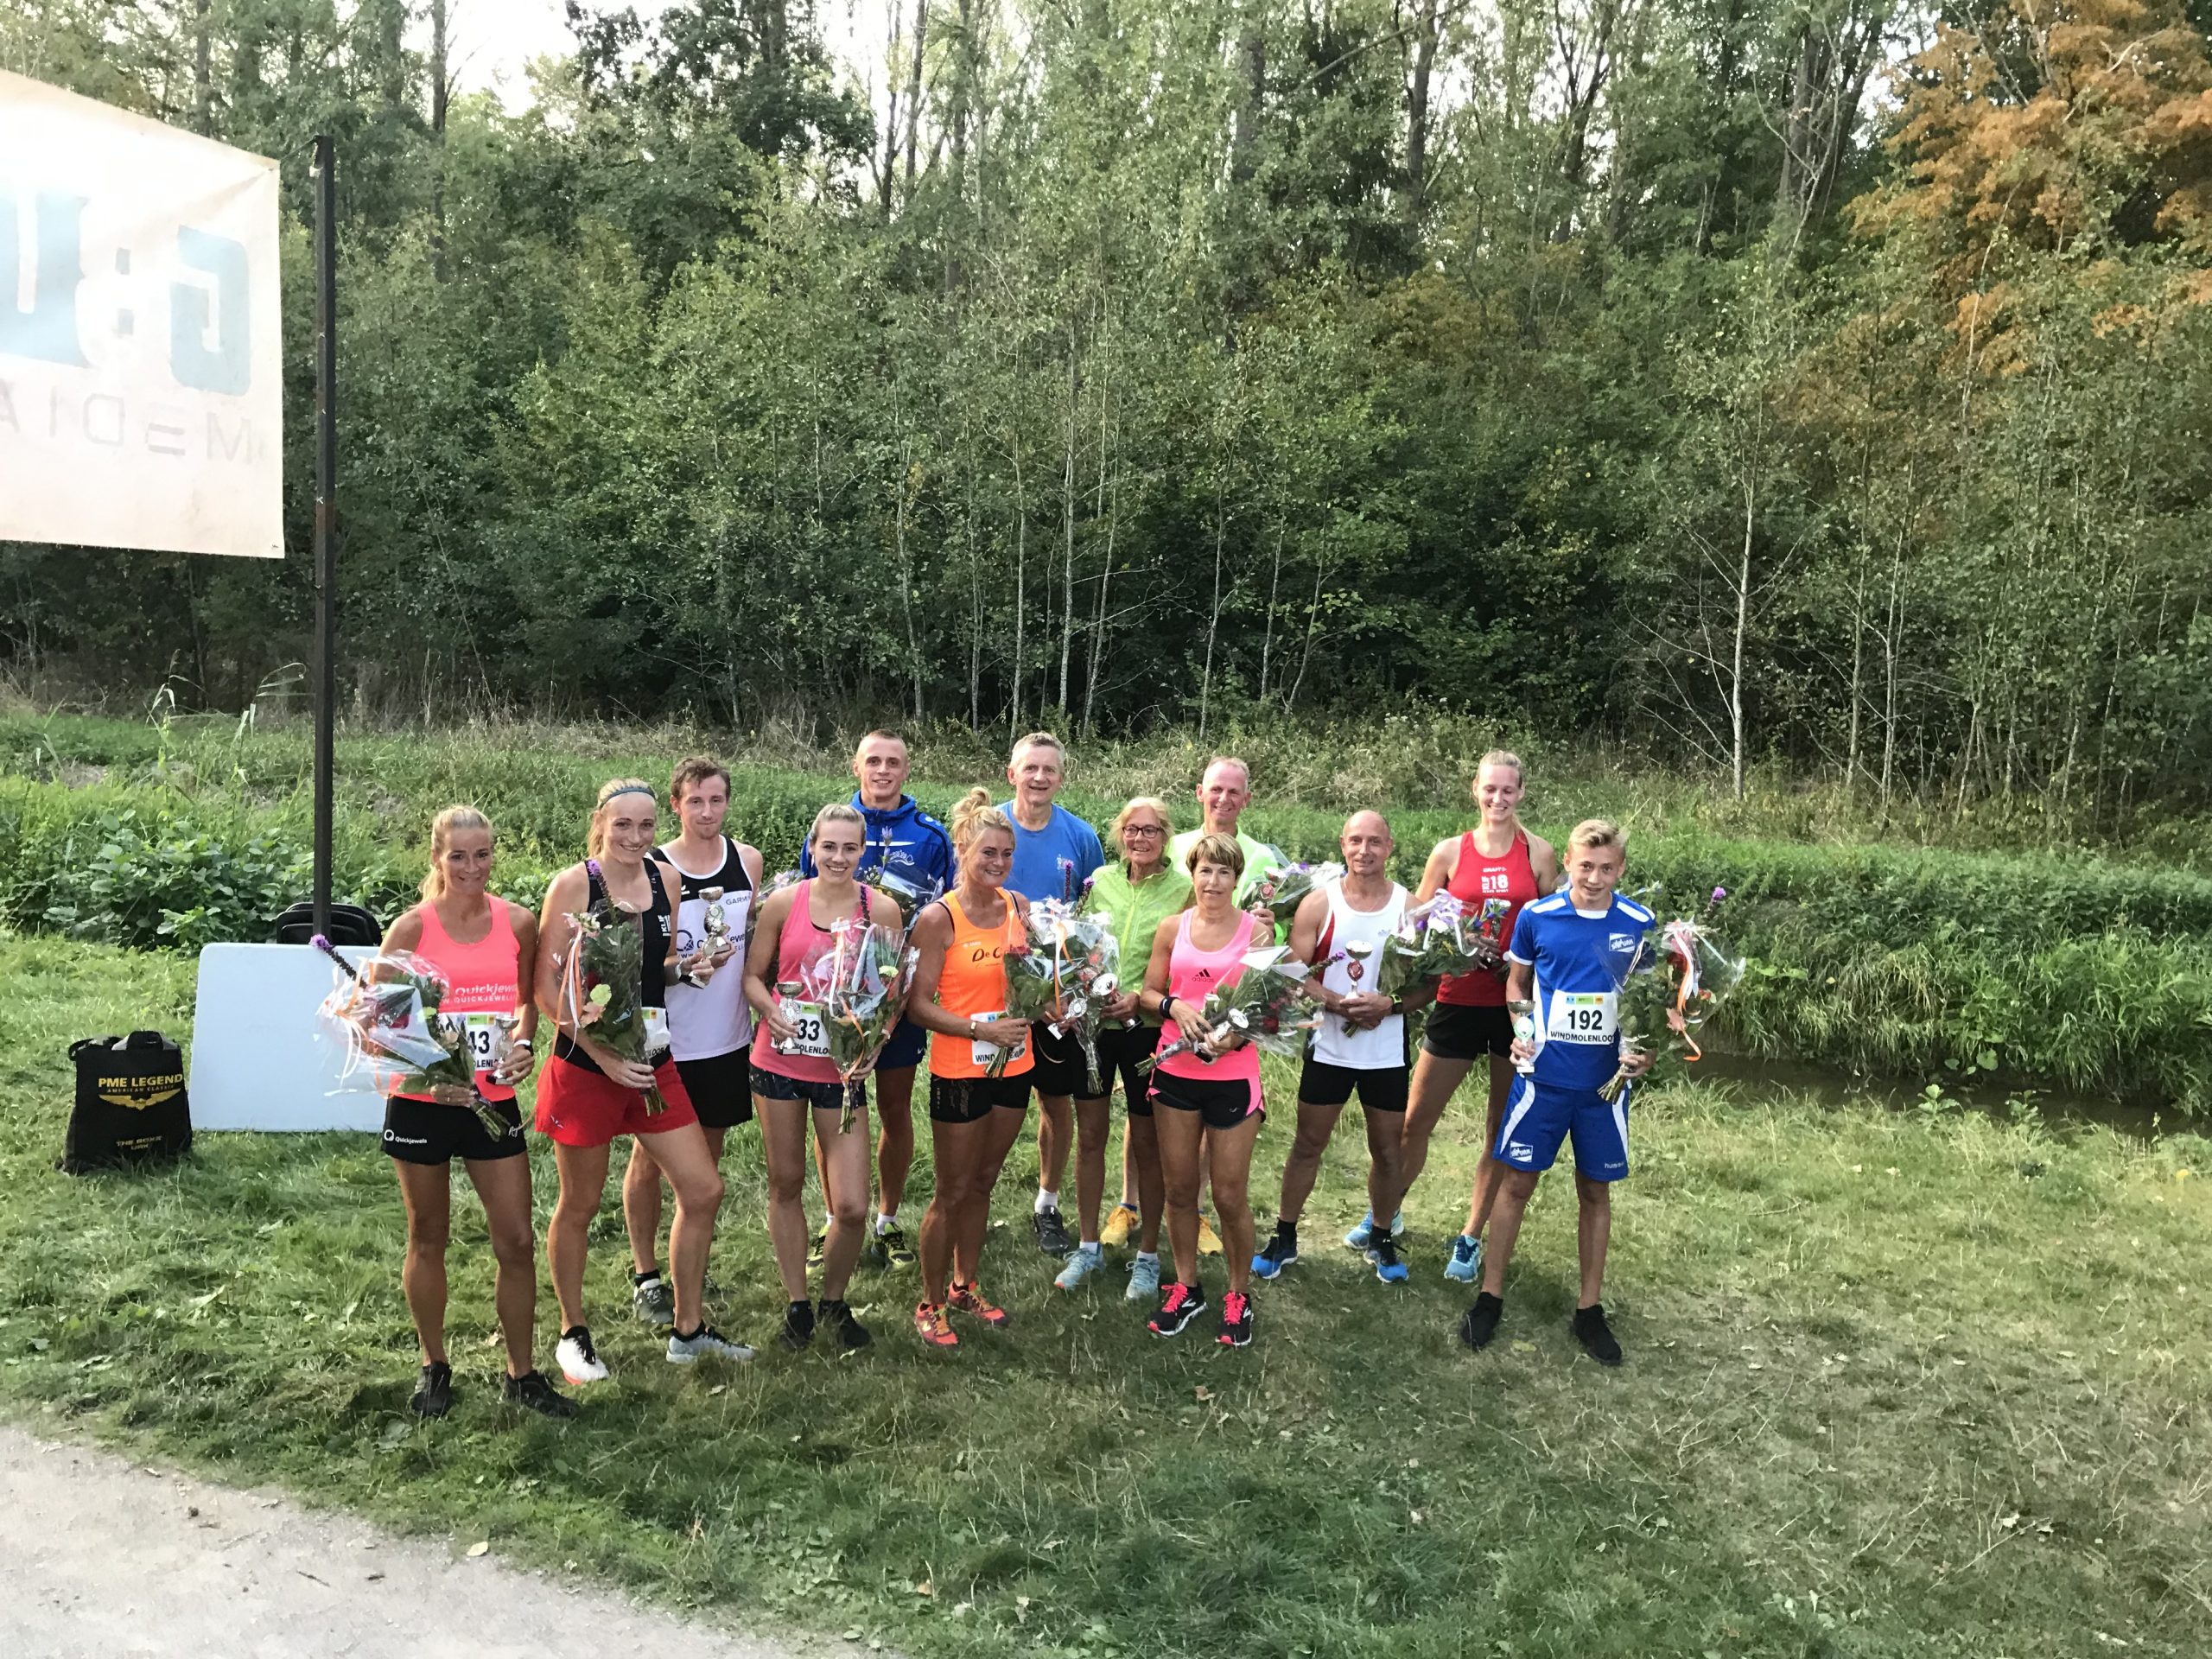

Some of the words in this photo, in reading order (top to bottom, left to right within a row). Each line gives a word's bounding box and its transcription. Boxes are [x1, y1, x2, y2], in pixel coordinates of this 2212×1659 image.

[1490, 874, 1509, 890] 18
[726, 893, 751, 906] GARM
[455, 983, 517, 995] Quickjew
[1567, 1009, 1603, 1030] 192
[798, 1019, 820, 1041] 33
[1550, 1031, 1613, 1042] WINDMOLENLOO
[99, 1077, 127, 1087] PME
[131, 1074, 183, 1087] LEGEND
